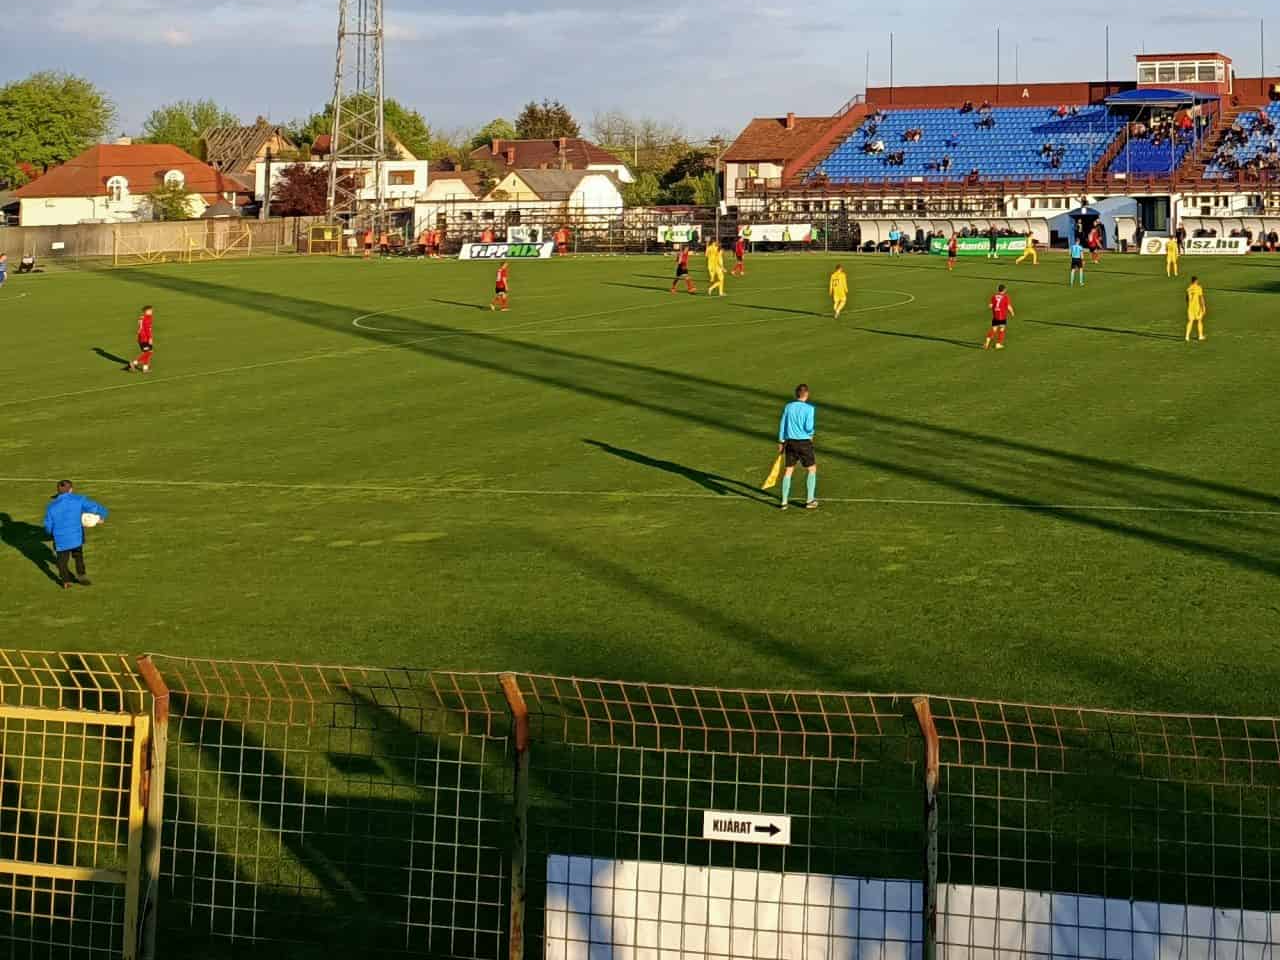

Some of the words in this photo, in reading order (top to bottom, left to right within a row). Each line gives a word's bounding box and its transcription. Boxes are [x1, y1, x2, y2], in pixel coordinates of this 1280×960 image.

[1021, 88, 1030, 98] A
[1184, 239, 1240, 249] lsz.hu
[712, 818, 752, 834] KIJÁRAT
